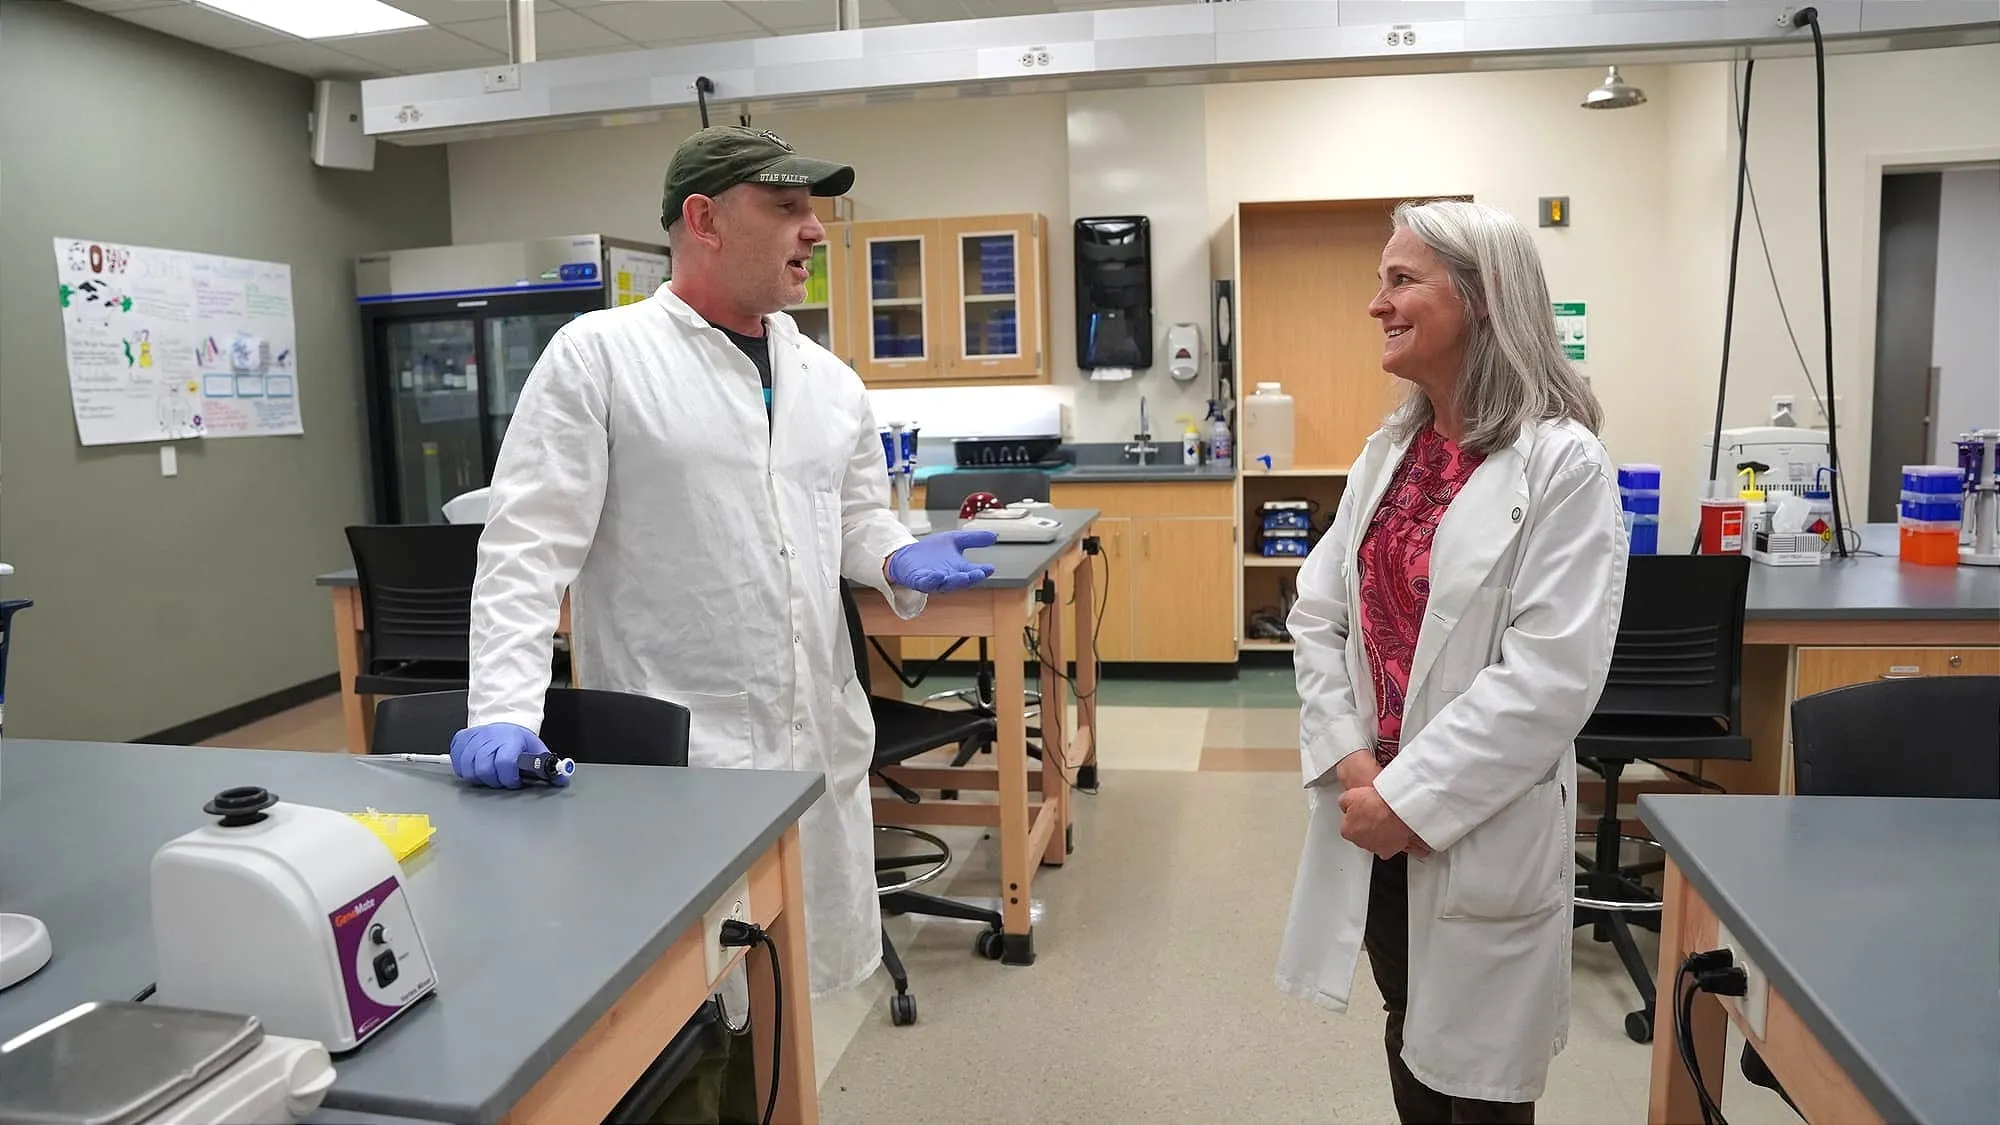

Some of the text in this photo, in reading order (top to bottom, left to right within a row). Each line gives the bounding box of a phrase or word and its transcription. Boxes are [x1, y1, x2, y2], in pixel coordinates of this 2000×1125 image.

[759, 173, 809, 184] UTAH VALLEY
[335, 898, 376, 928] GeneMate
